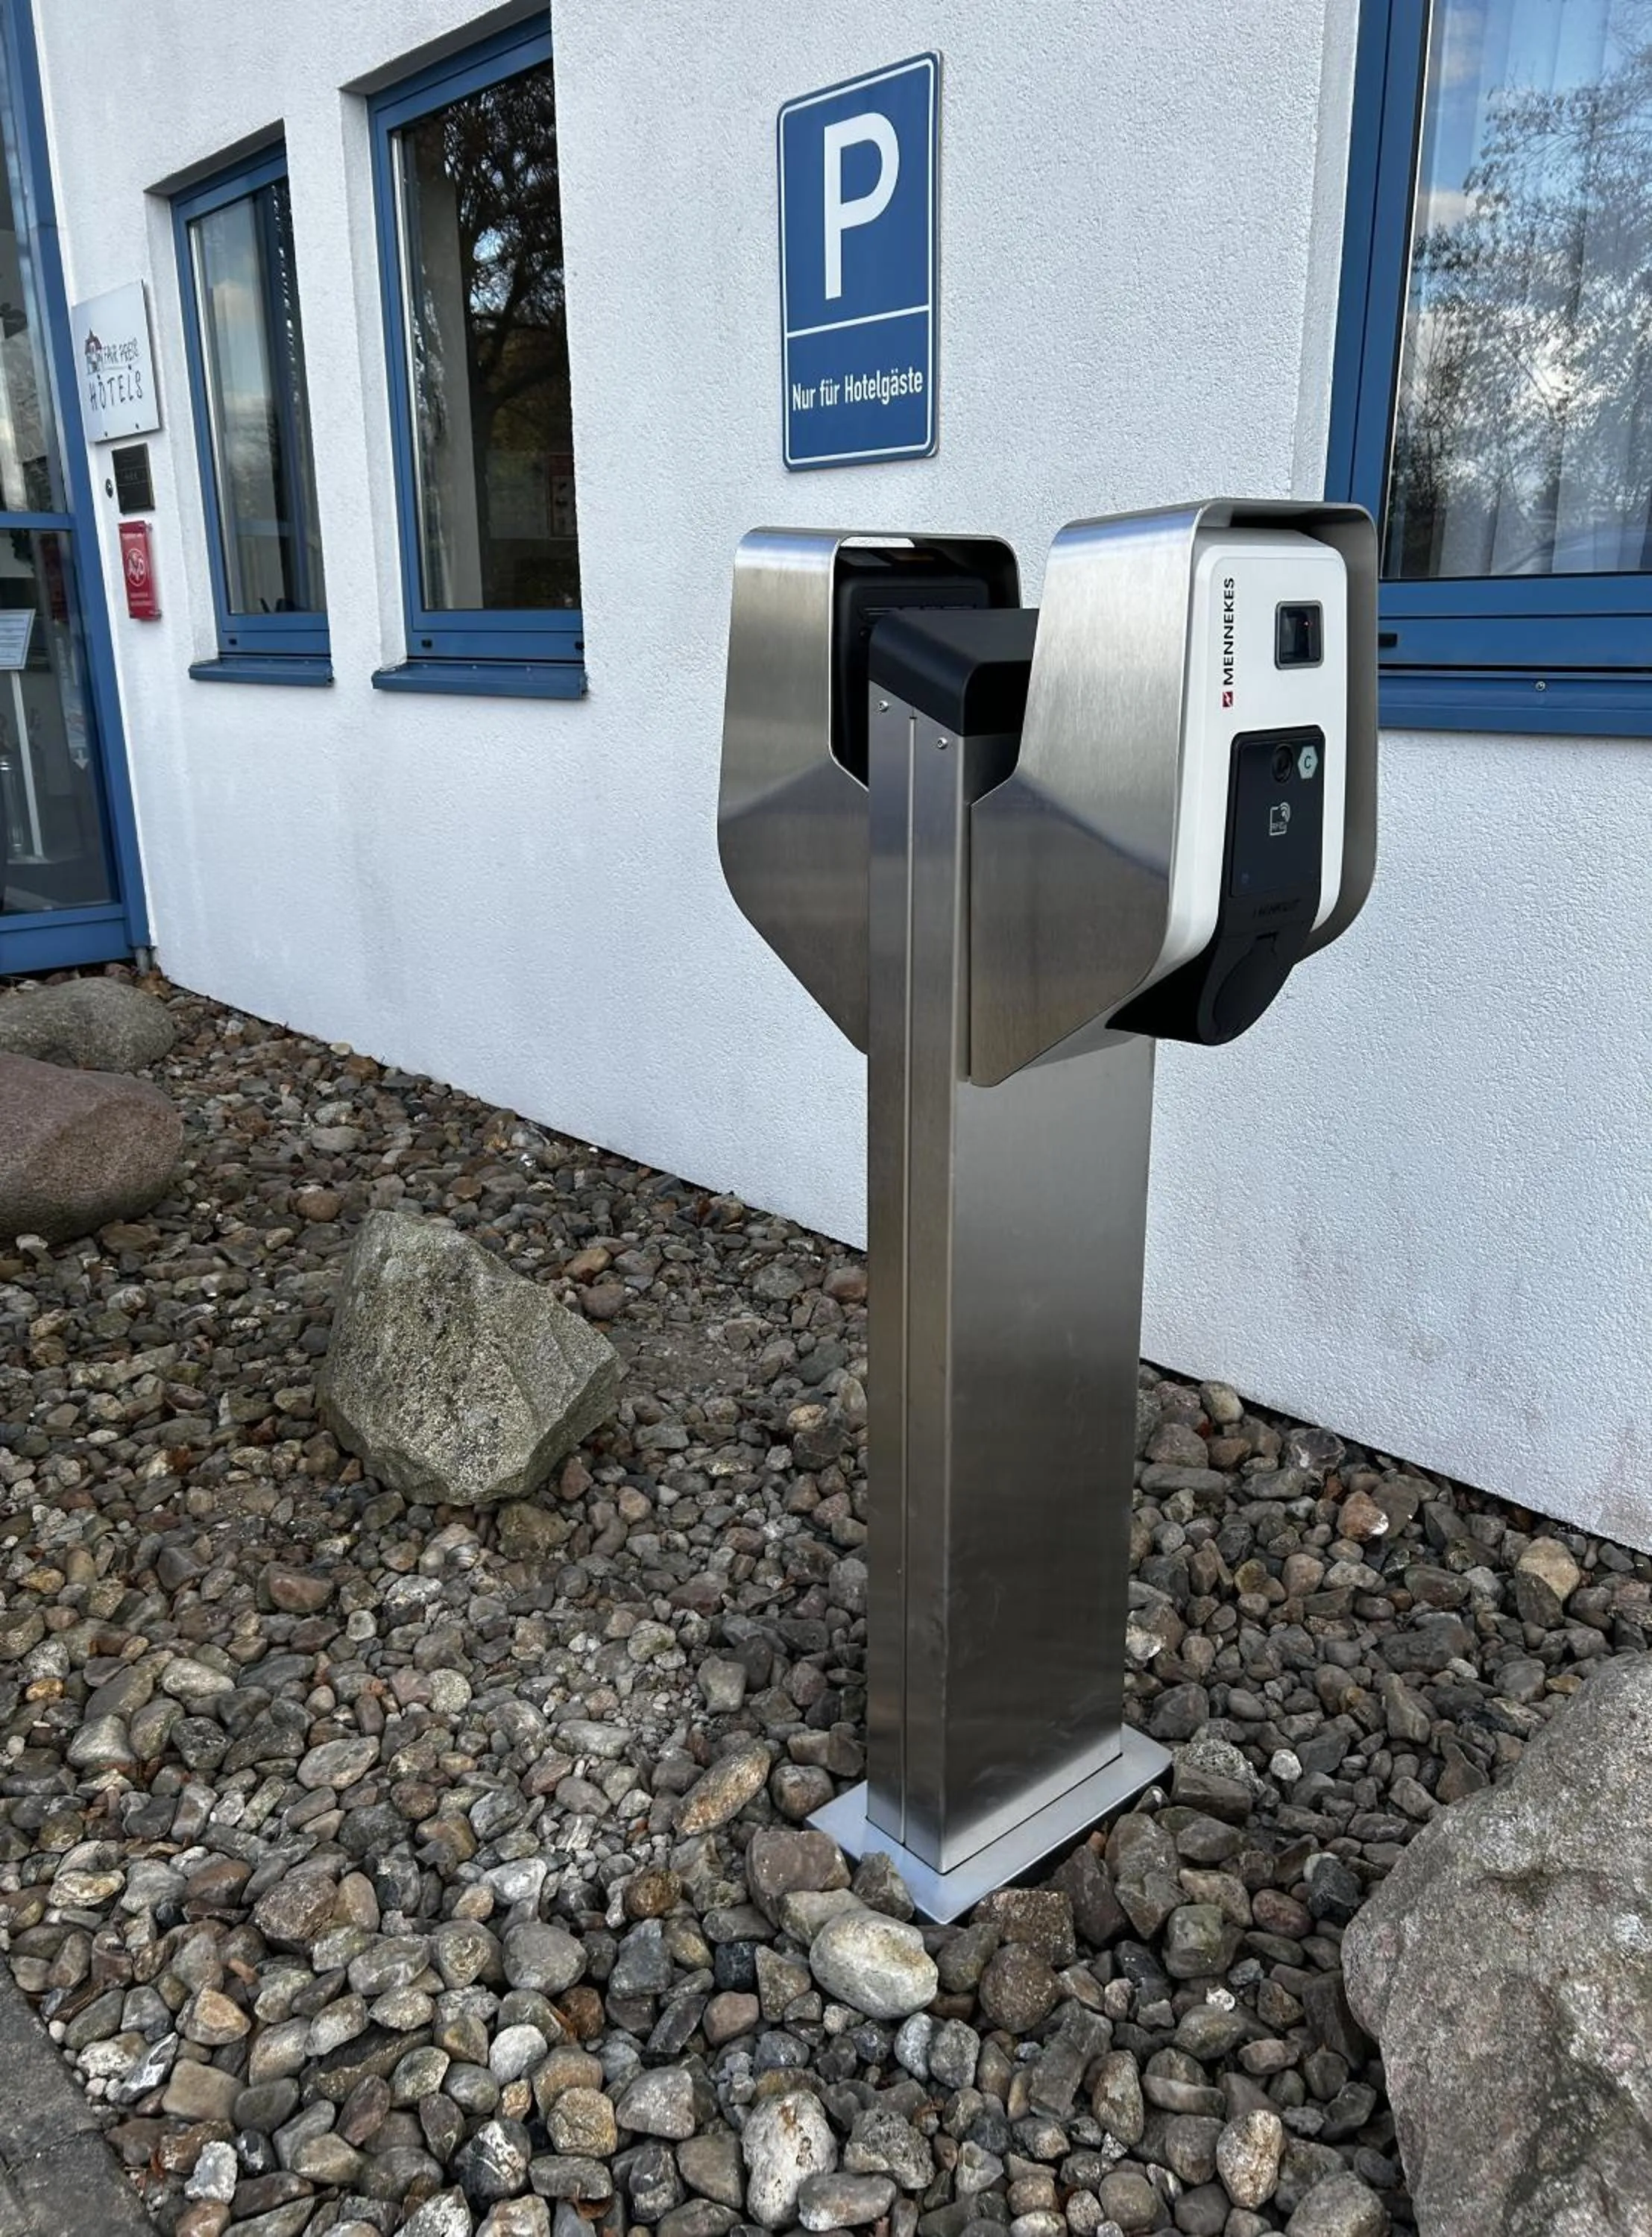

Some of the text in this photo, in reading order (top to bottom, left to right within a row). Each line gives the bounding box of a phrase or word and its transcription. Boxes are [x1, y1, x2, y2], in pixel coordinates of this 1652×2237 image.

[825, 113, 899, 300] P
[89, 371, 143, 412] HOTELS
[792, 366, 923, 411] Nur für Hotelgäste
[1223, 577, 1235, 685] MENNEKES
[1304, 755, 1311, 770] C
